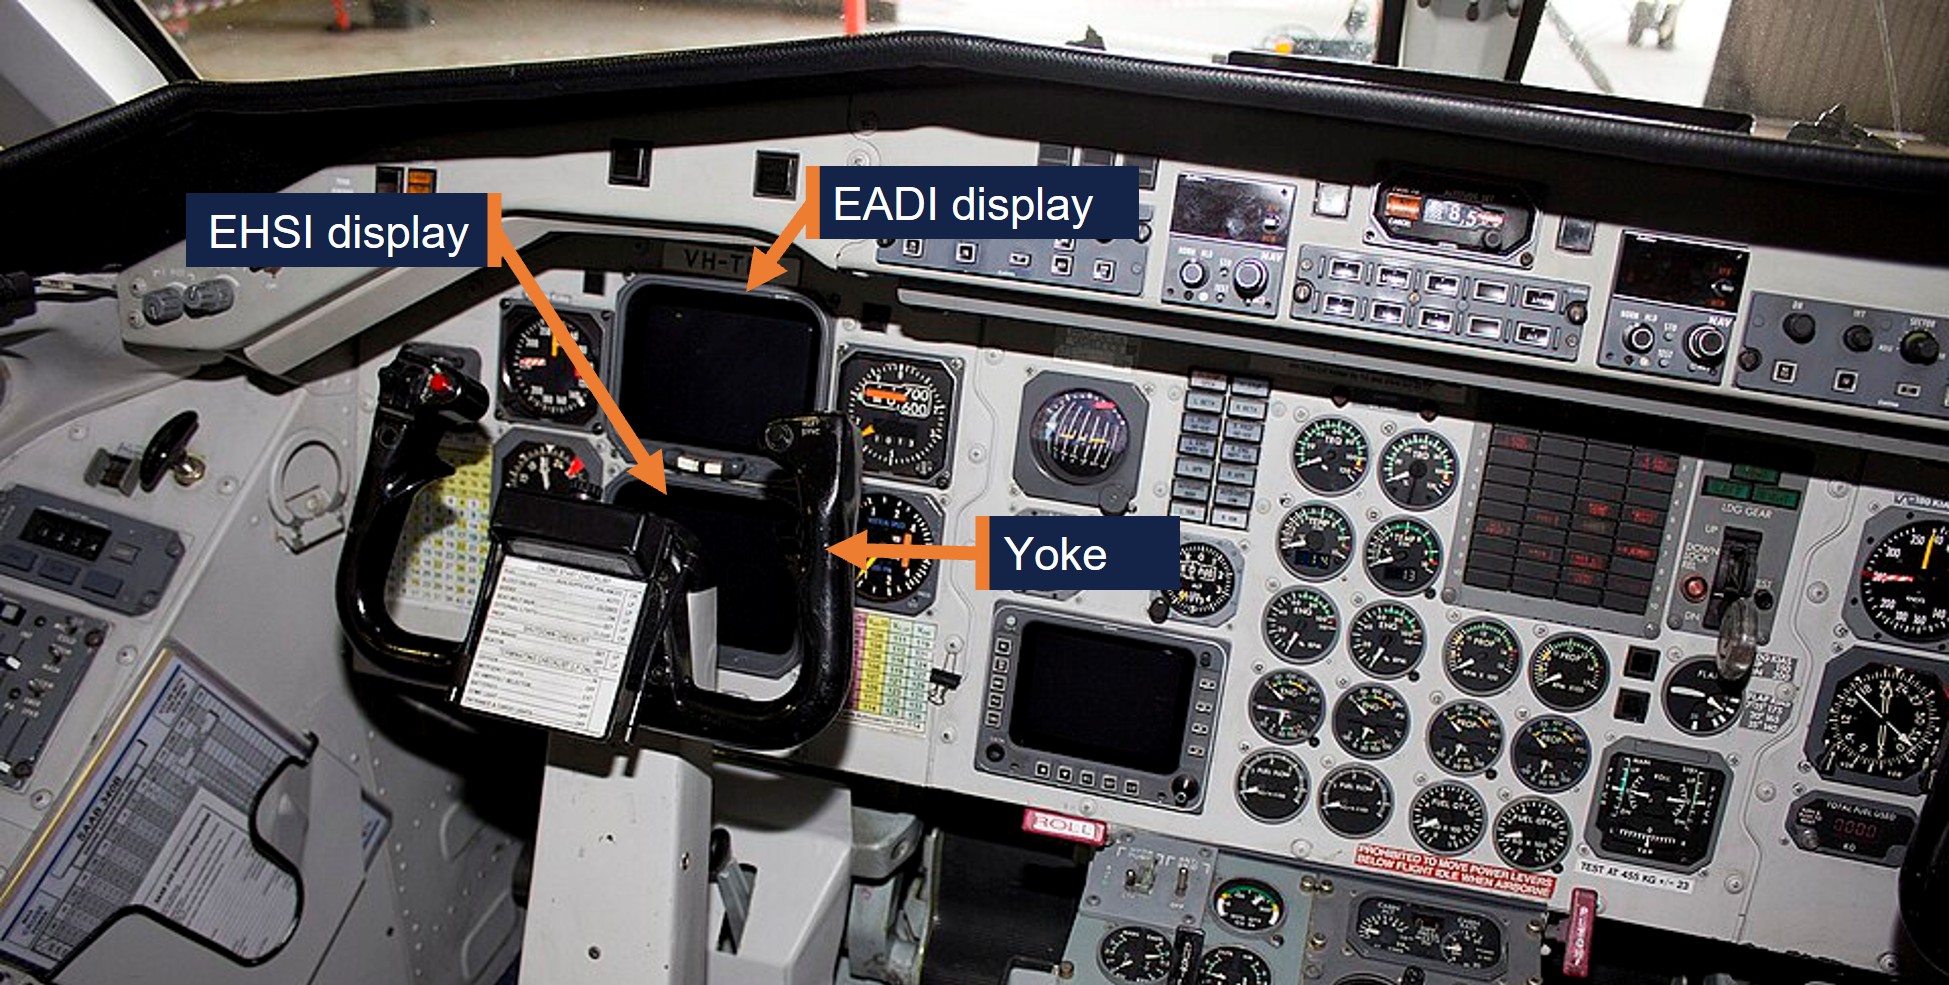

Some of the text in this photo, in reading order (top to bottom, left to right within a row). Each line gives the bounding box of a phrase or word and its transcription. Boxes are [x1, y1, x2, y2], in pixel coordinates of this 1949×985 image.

[684, 249, 751, 275] VH-T
[1708, 316, 1733, 327] NAV
[904, 387, 929, 401] 700
[901, 402, 927, 416] 600
[1721, 503, 1773, 519] LDG GEAR
[1705, 524, 1718, 533] UP
[1686, 541, 1720, 556] DOWN
[1683, 551, 1709, 563] LOCK
[1879, 598, 1896, 610] 200
[1684, 610, 1700, 621] DN
[1912, 613, 1927, 625] 160
[1932, 608, 1947, 620] 140
[1472, 637, 1495, 647] PROP
[1559, 651, 1582, 662] PROP
[1697, 670, 1718, 680] FLA
[1256, 766, 1291, 778] FUEL FLOW
[1340, 781, 1374, 792] FUEL FLOW
[1431, 798, 1470, 812] FUEL QTY
[1826, 800, 1897, 822] TOTAL FUEL USED
[76, 806, 103, 842] SAAB
[1031, 813, 1092, 836] ROLL
[1515, 813, 1552, 827] FUEL QTY
[1358, 843, 1553, 888] PROHIBITED TO MOVE POWER LEVERS
[1357, 854, 1552, 897] BELOW FLIGHT IDLE WHEN AIRBORNE
[1580, 861, 1604, 874] TEST
[1607, 866, 1619, 876] AT
[1621, 868, 1640, 881] 455
[1642, 873, 1656, 885] KG
[1676, 879, 1690, 891] 23
